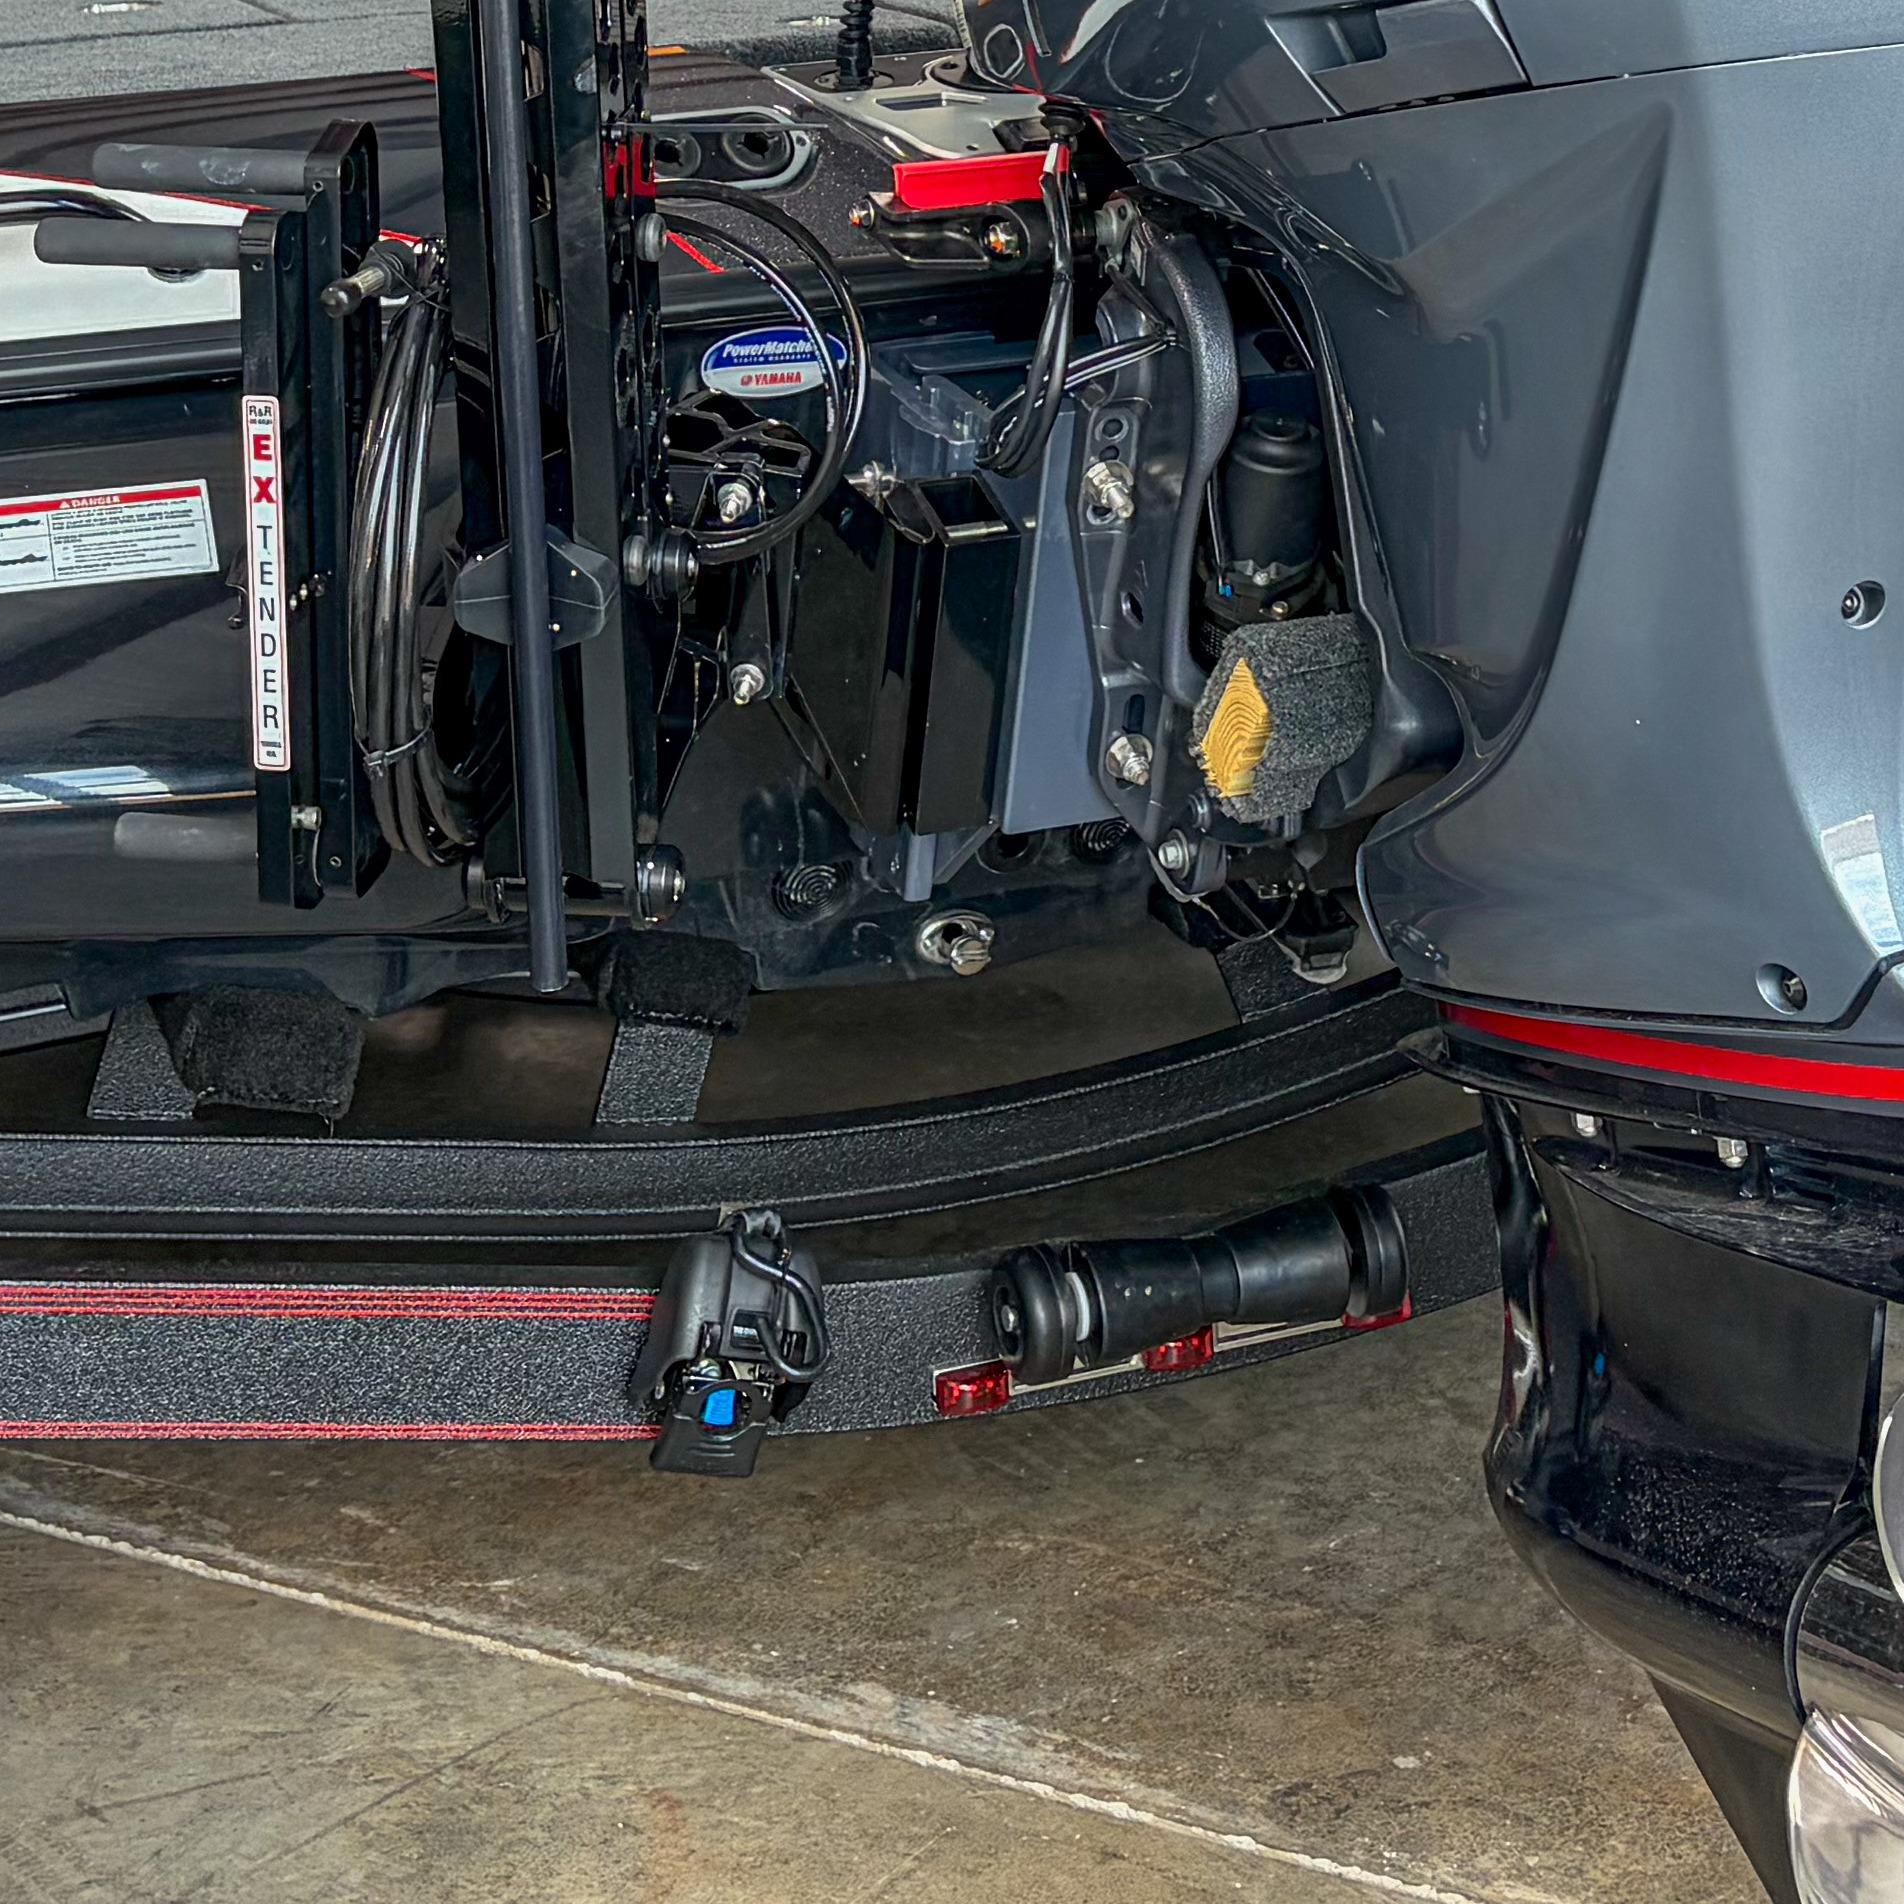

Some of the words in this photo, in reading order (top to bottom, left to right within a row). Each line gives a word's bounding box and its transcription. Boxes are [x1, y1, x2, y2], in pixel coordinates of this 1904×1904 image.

[722, 339, 813, 357] PowerMatche
[755, 371, 802, 385] YAMAHA
[71, 496, 121, 508] DANGER
[252, 433, 280, 730] EXTENDER
